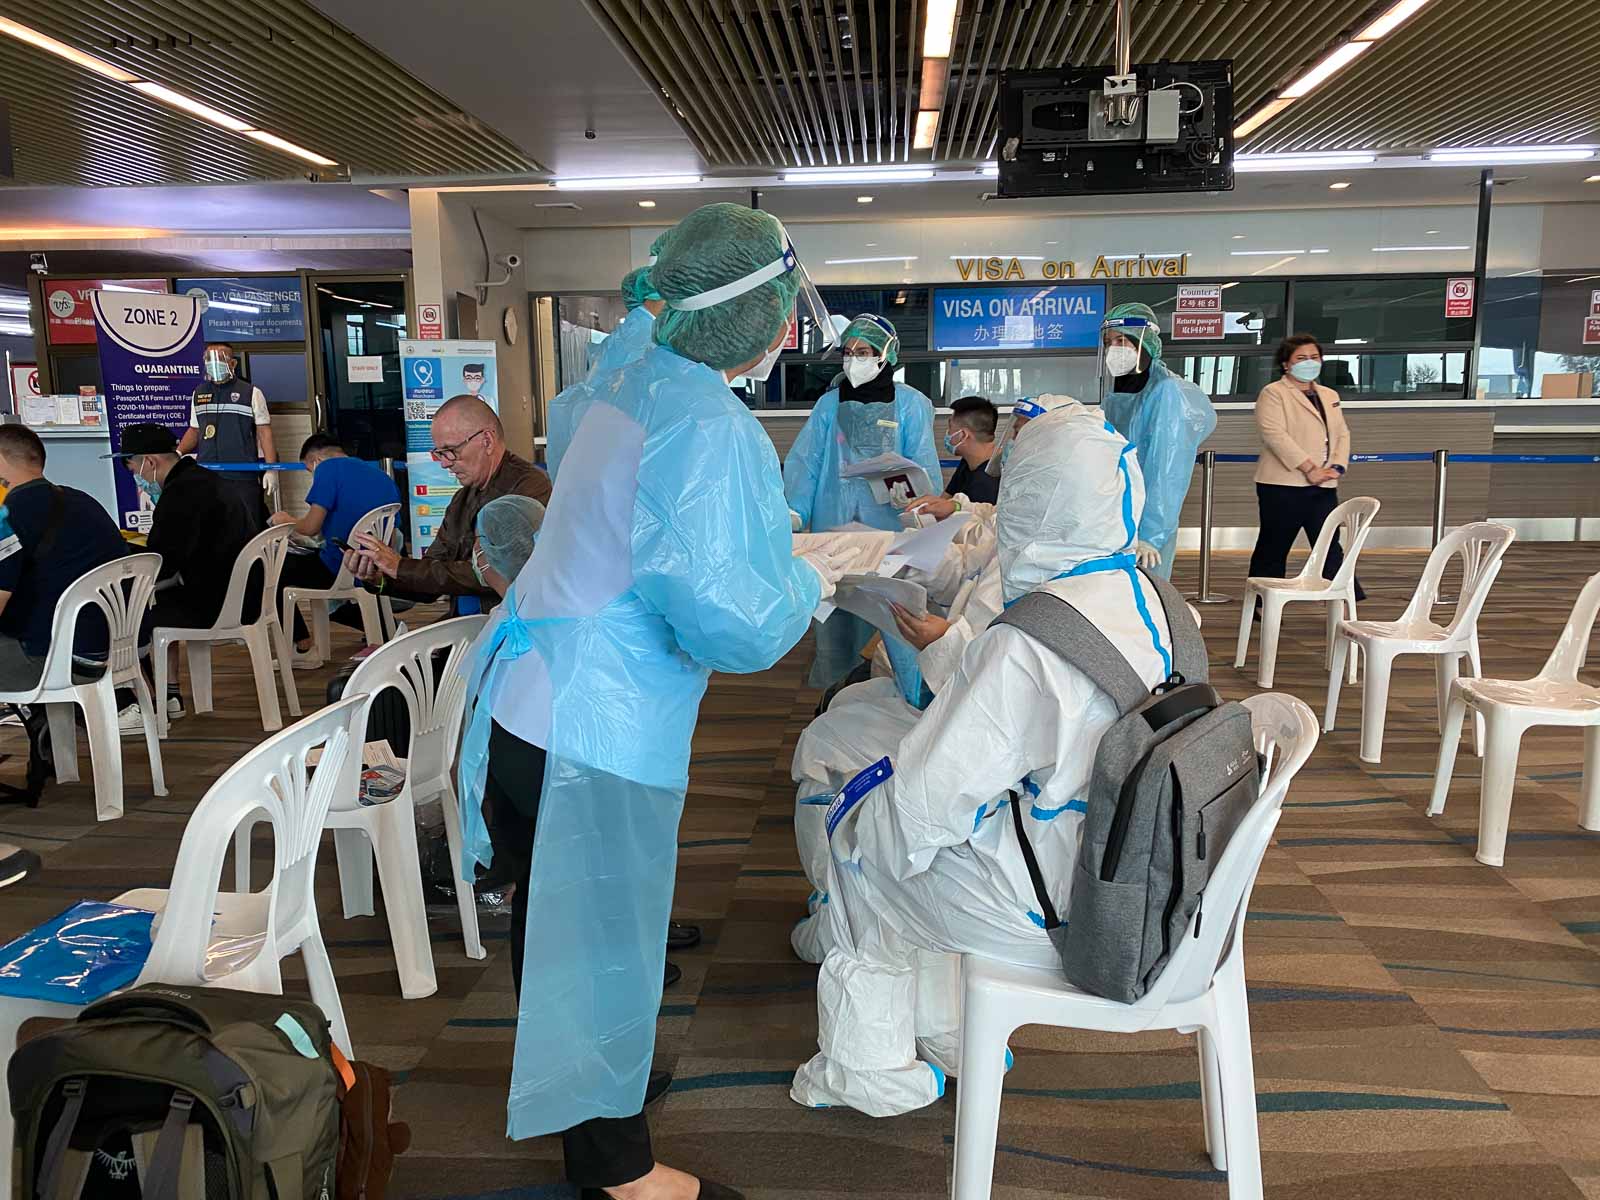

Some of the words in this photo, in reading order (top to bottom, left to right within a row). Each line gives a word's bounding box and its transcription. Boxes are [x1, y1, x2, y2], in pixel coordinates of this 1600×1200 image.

[956, 257, 1025, 281] VISA
[1042, 260, 1075, 279] on
[1091, 254, 1188, 279] Arrival
[212, 291, 242, 302] E-VOA
[244, 291, 301, 303] PASSENGER
[943, 299, 985, 319] VISA
[989, 298, 1014, 318] ON
[1018, 297, 1097, 317] ARRIVAL
[124, 307, 167, 326] ZONE
[169, 310, 179, 327] 2
[208, 319, 231, 327] Please
[232, 319, 249, 327] show
[250, 320, 265, 328] your
[266, 319, 302, 327] documents
[974, 323, 1064, 342] 办理地签
[134, 364, 200, 375] QUARANTINE
[111, 384, 135, 393] Things
[143, 385, 171, 393] prepare:
